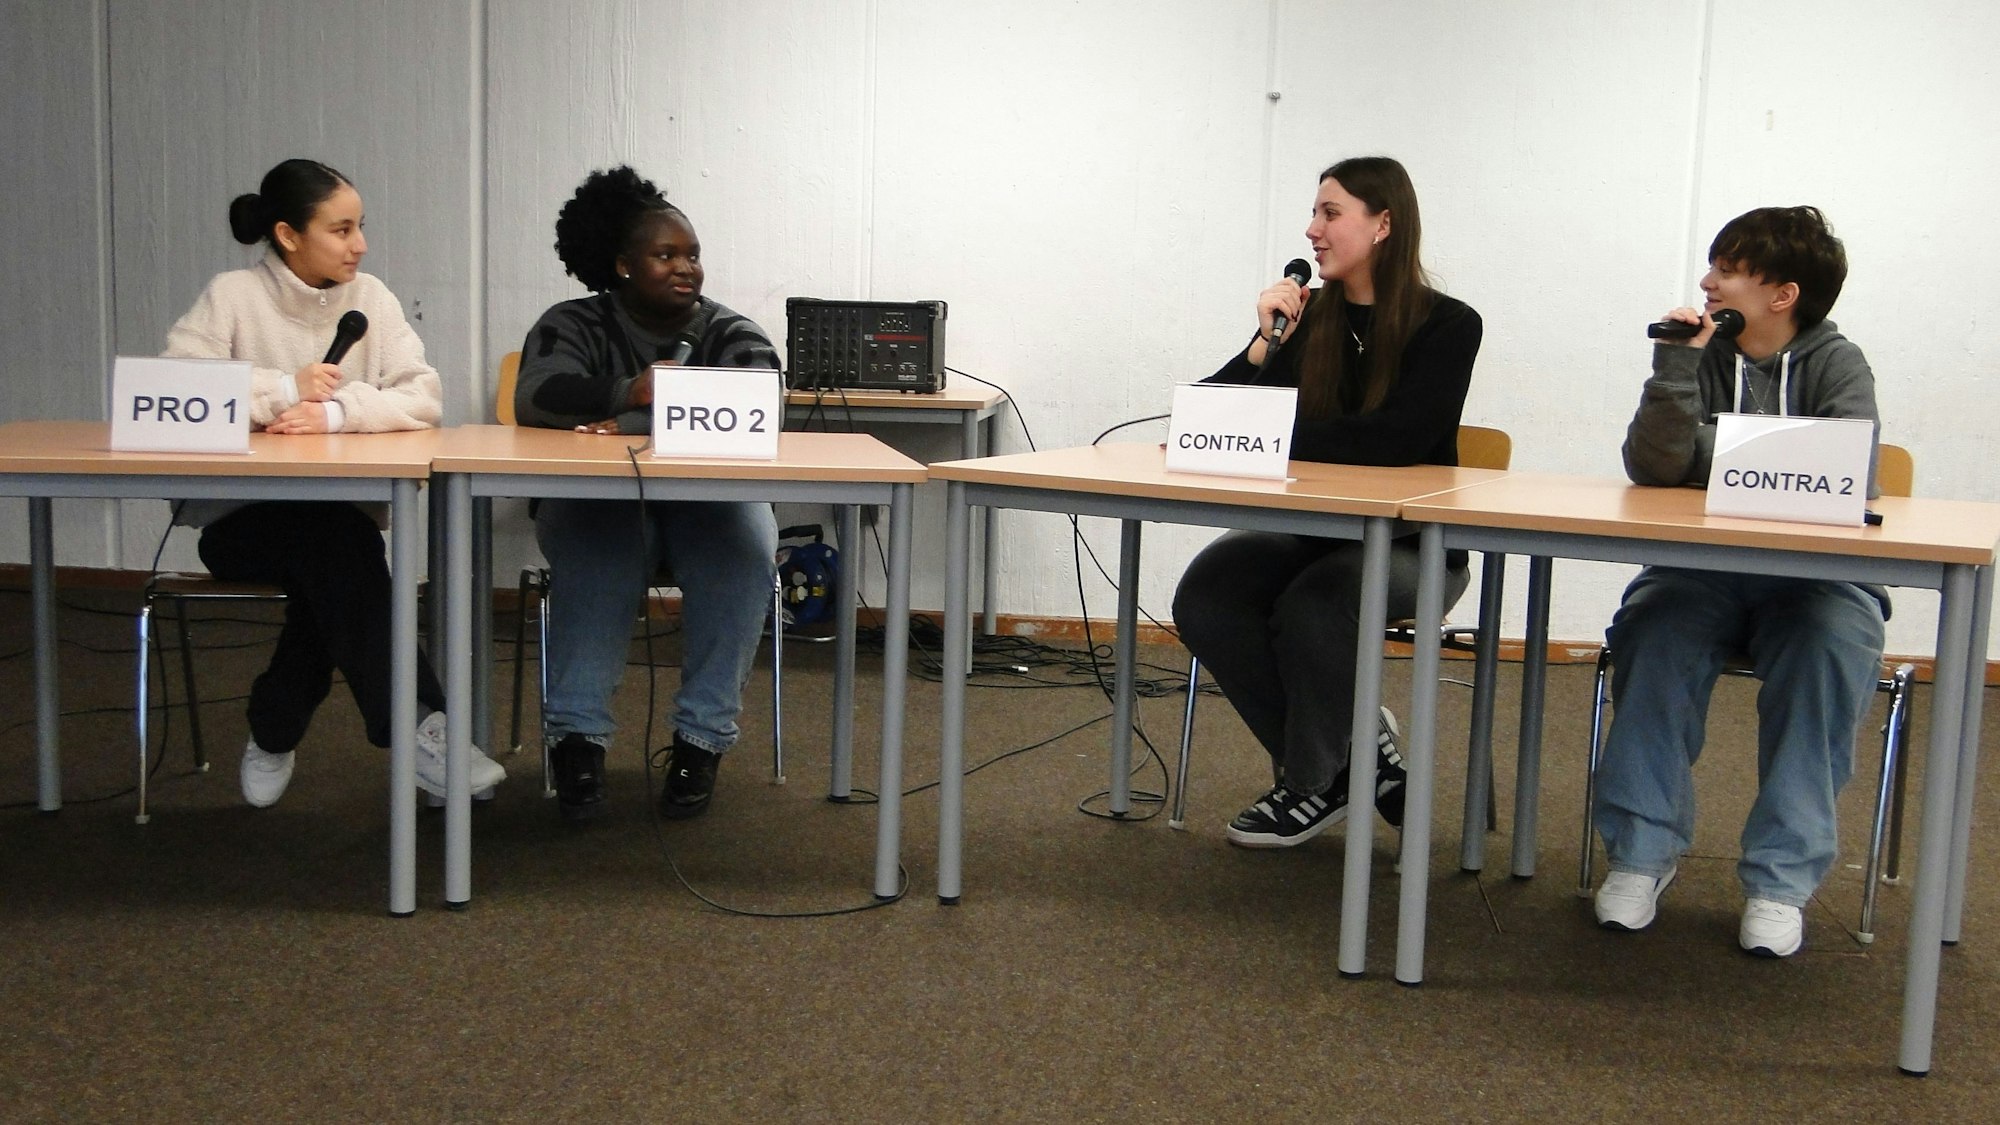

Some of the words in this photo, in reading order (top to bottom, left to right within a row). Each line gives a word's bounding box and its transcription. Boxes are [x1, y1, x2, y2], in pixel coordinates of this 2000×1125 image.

[133, 395, 209, 423] PRO
[224, 398, 236, 424] 1
[667, 405, 737, 432] PRO
[749, 409, 765, 433] 2
[1179, 433, 1264, 453] CONTRA
[1273, 438, 1281, 453] 1
[1724, 469, 1831, 494] CONTRA
[1839, 477, 1853, 496] 2
